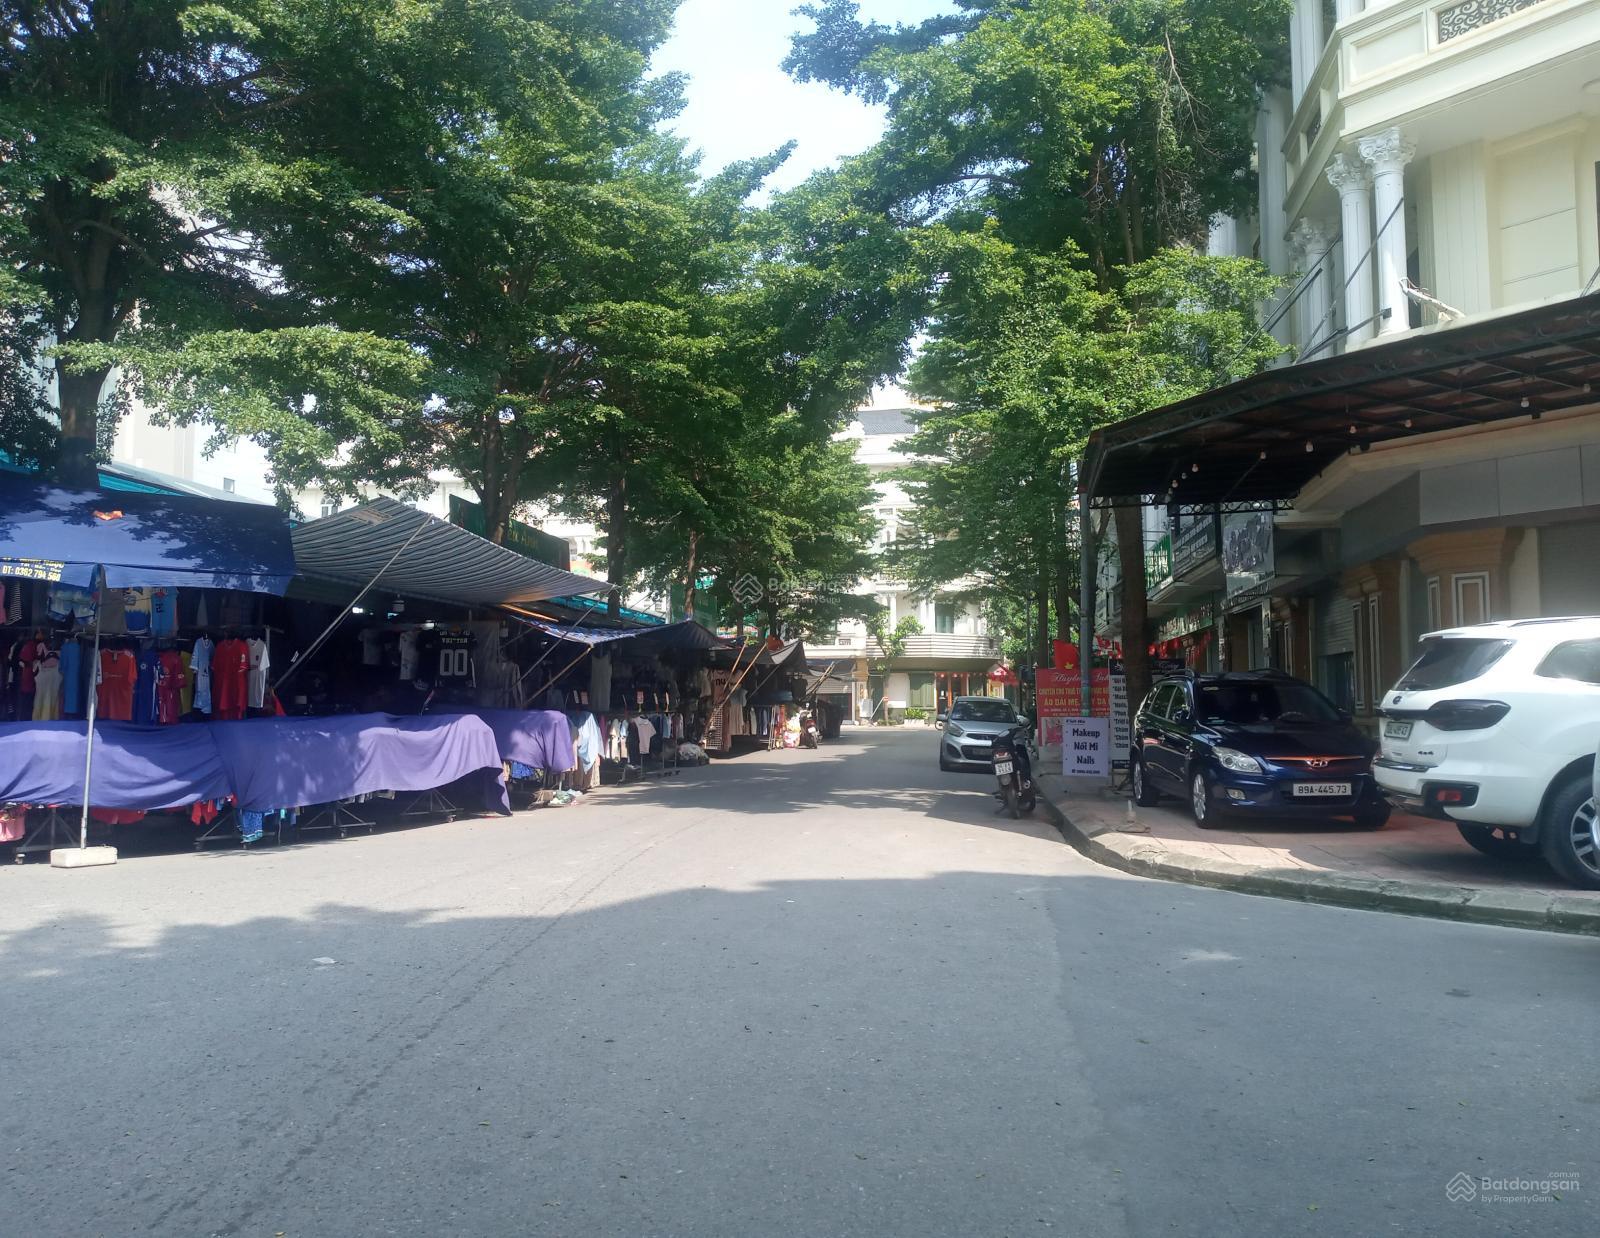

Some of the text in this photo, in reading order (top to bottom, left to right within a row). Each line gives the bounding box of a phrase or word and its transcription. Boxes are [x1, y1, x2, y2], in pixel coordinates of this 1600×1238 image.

[439, 648, 468, 676] 00
[1072, 728, 1101, 738] Makeup
[1074, 741, 1098, 751] Nối Mi
[1076, 756, 1095, 765] Nails
[1298, 784, 1347, 794] 89A-445.73
